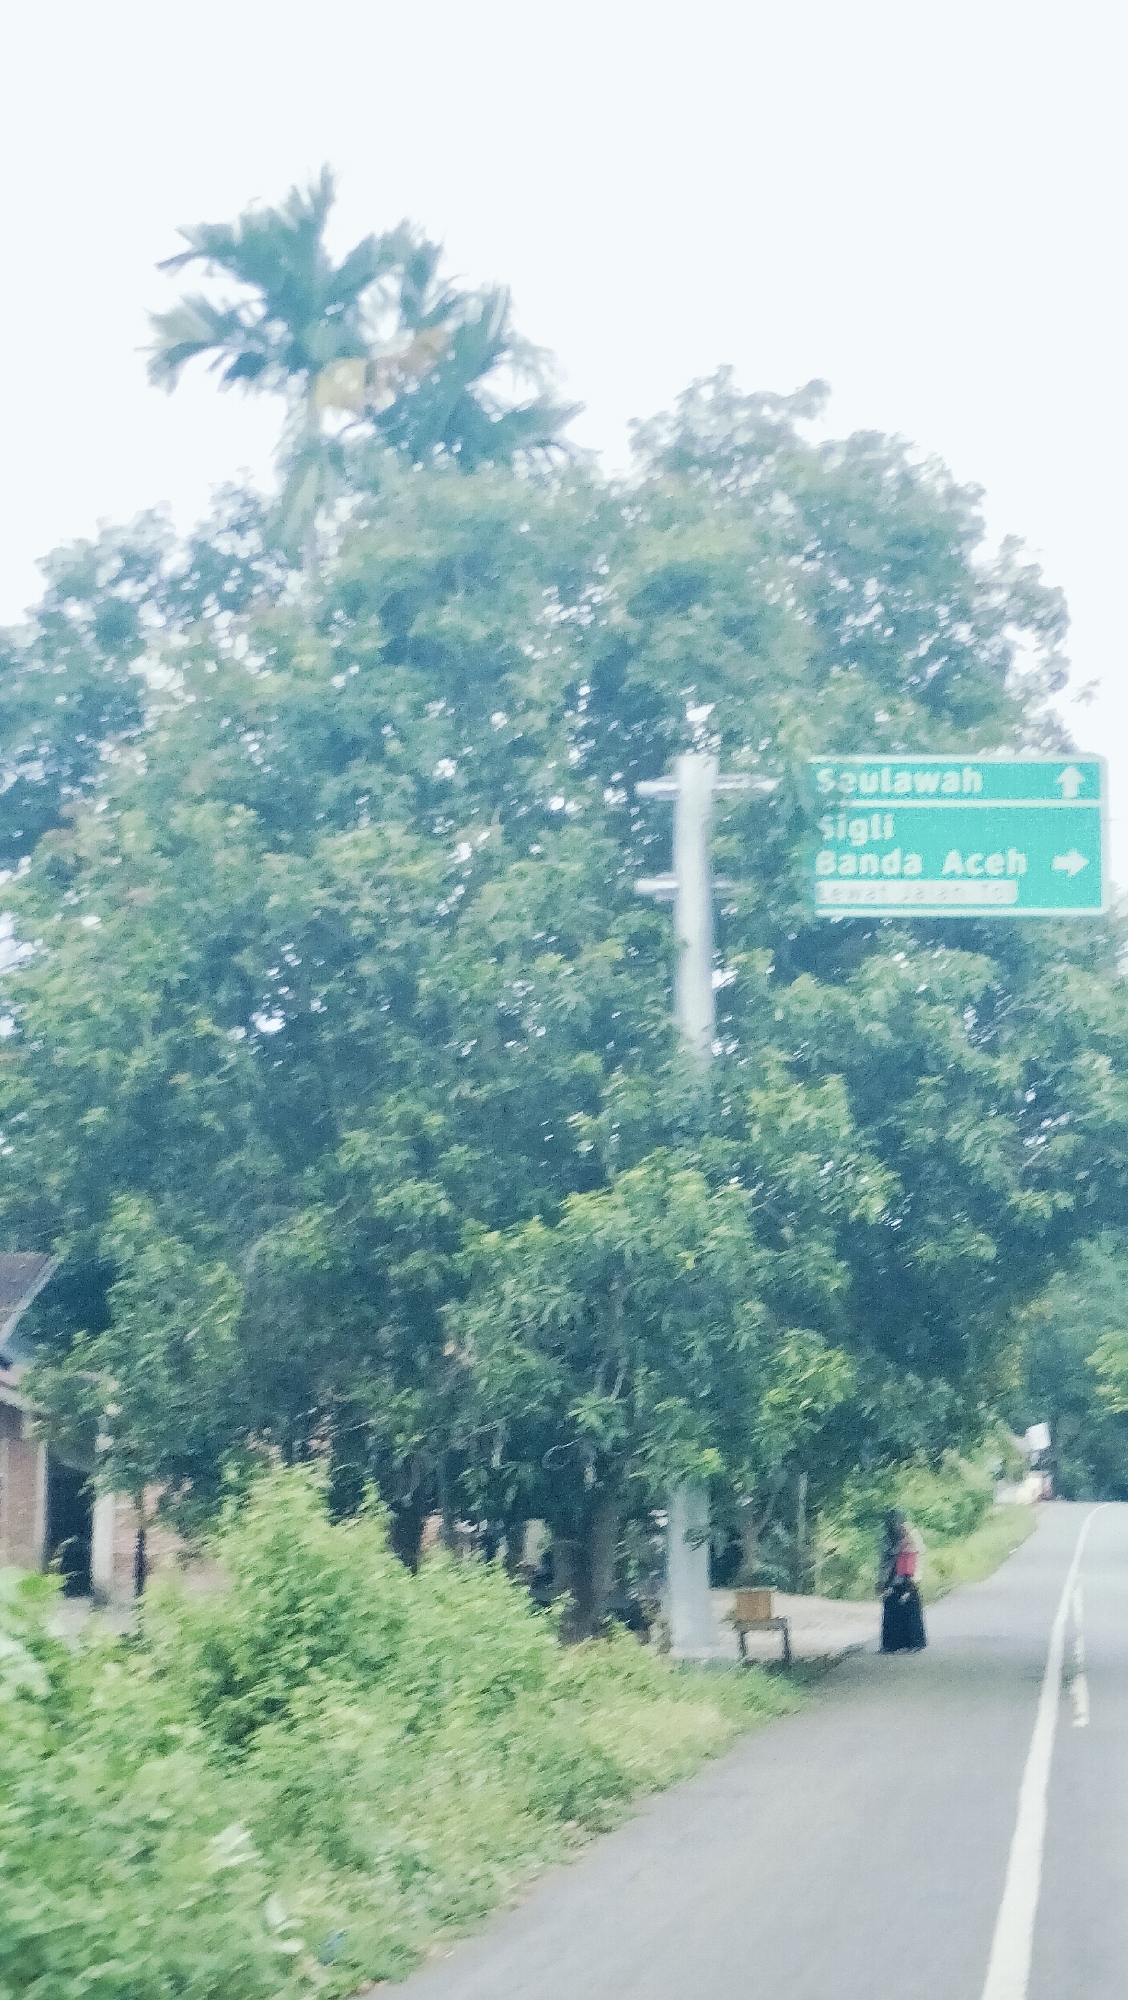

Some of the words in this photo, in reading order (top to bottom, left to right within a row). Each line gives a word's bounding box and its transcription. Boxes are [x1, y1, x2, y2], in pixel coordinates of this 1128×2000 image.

[816, 767, 983, 793] Seulawah
[817, 813, 894, 846] Sigli
[815, 847, 923, 875] Banda
[942, 847, 1028, 875] Aceh
